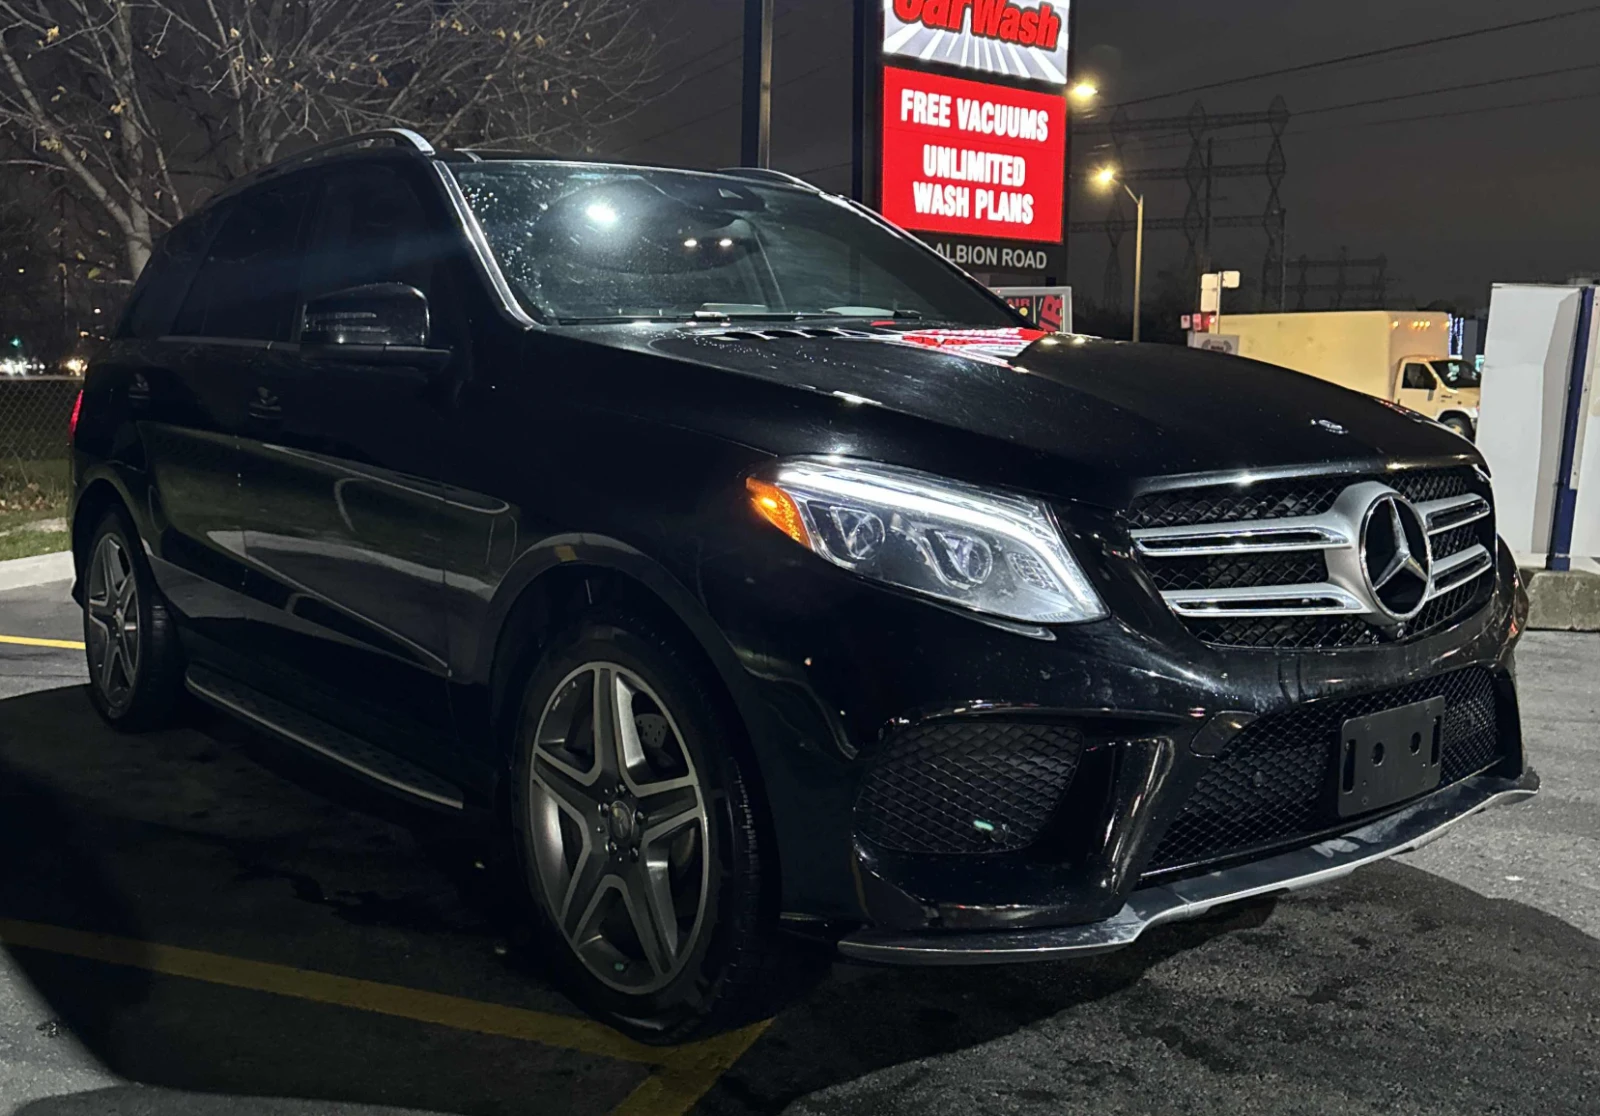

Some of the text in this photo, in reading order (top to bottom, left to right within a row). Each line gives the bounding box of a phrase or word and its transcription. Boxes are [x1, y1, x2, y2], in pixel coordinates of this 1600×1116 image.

[901, 88, 1049, 142] FREE VACUUMS
[923, 144, 1026, 187] UNLIMITED
[913, 181, 1034, 225] WASH PLANS
[935, 243, 1047, 269] ALBION ROAD
